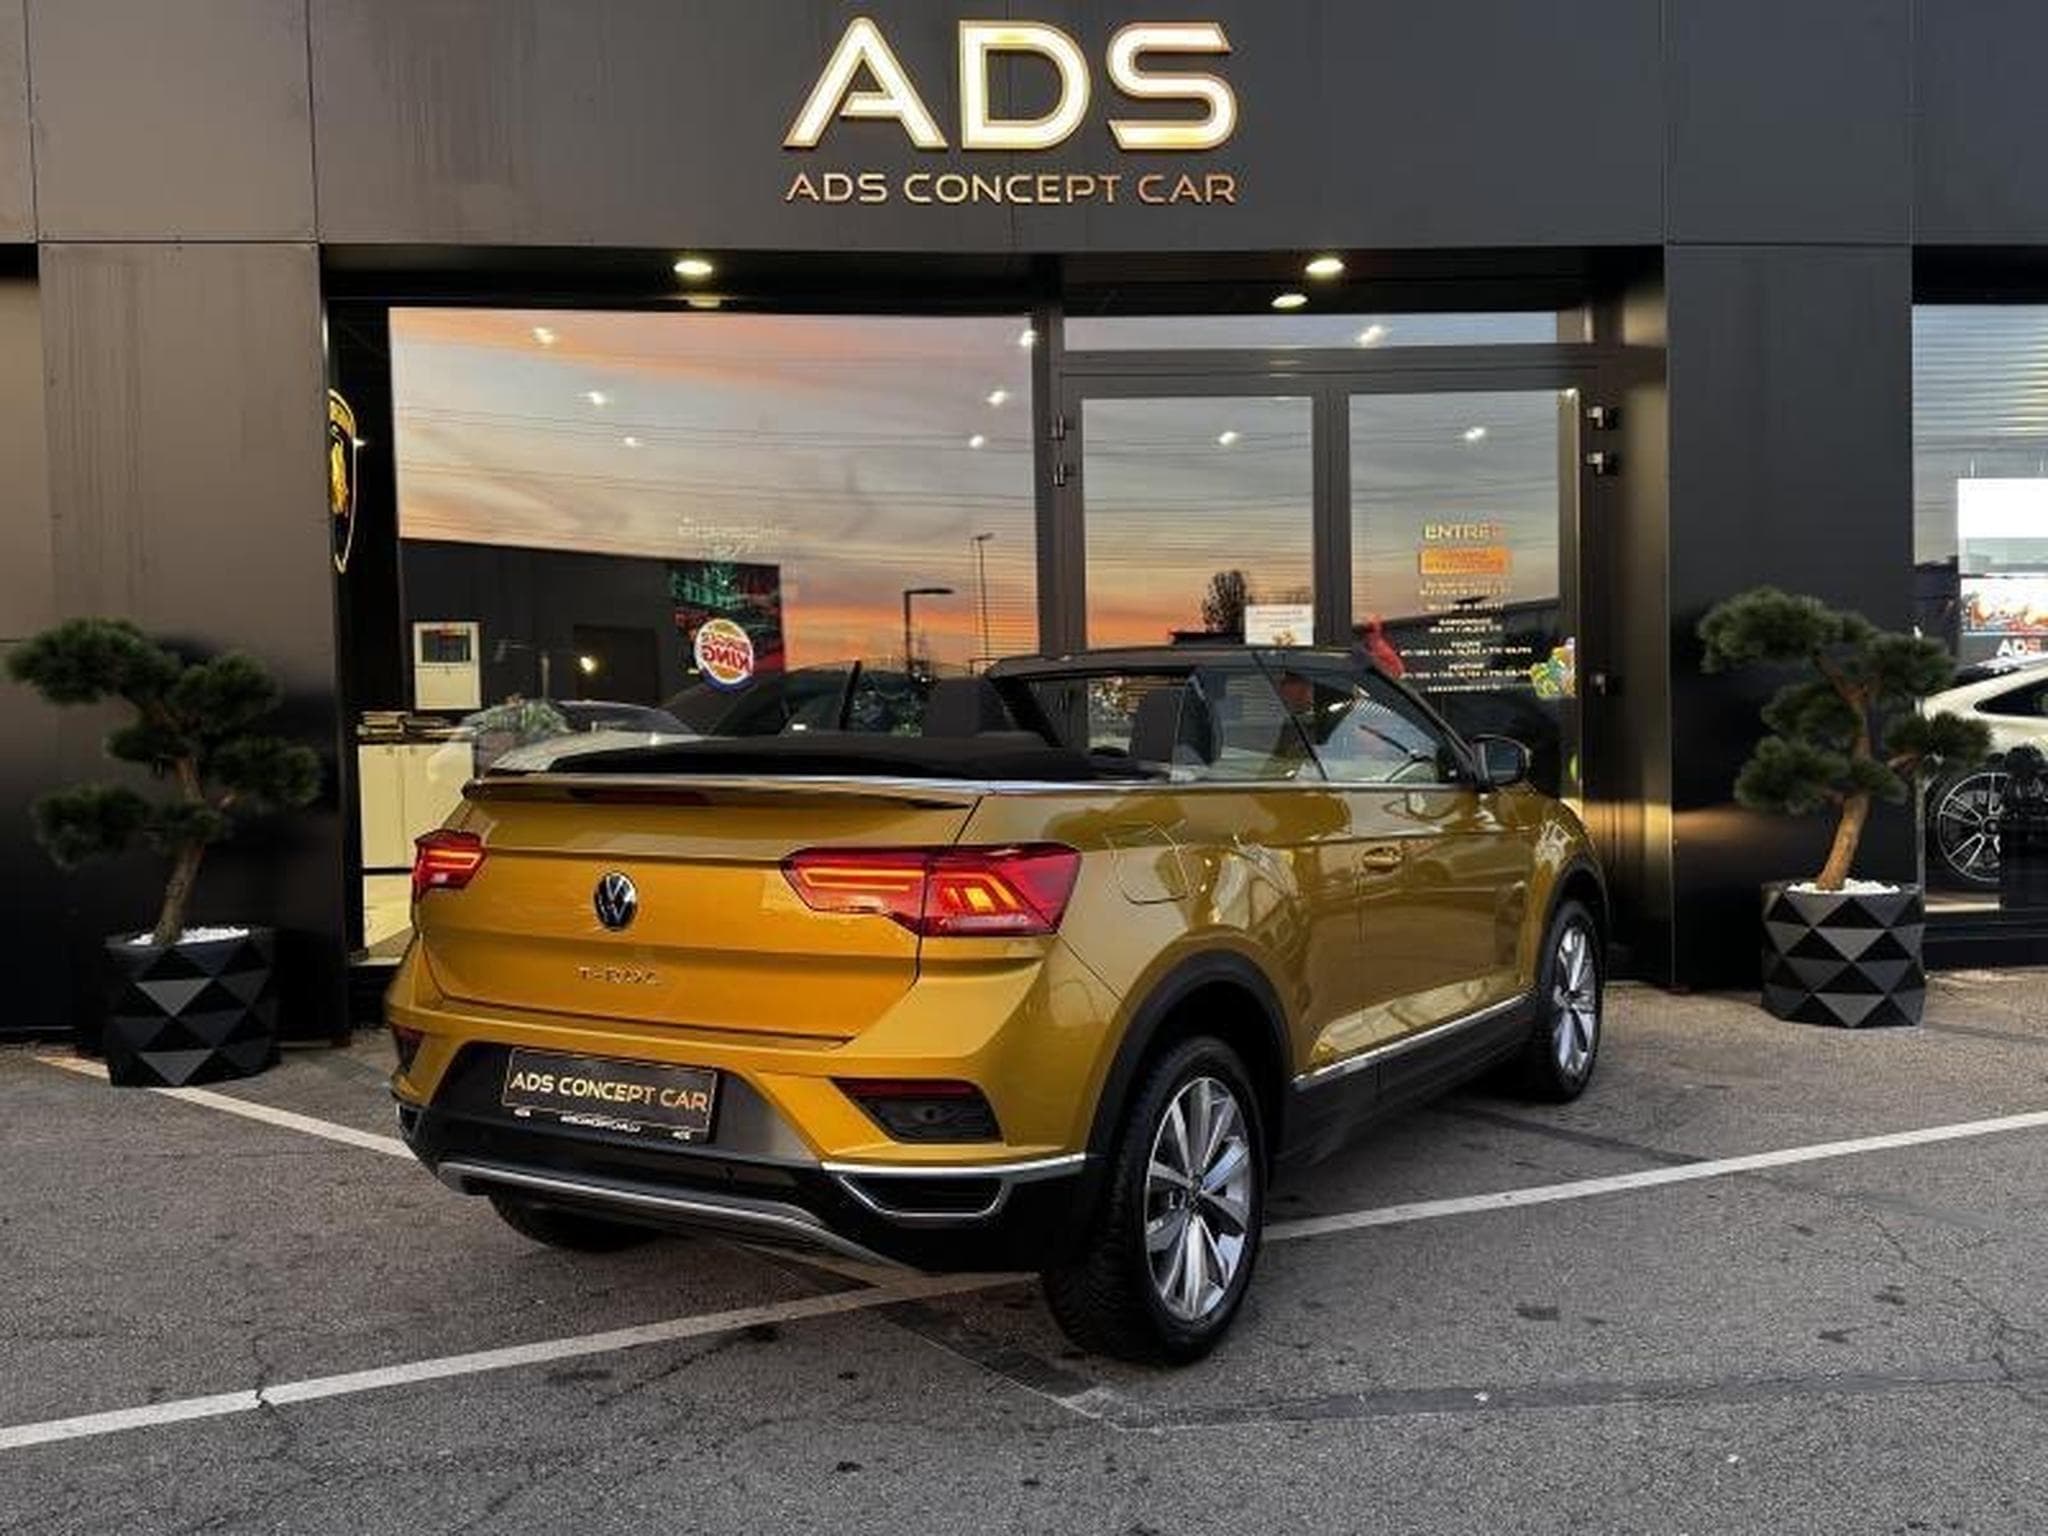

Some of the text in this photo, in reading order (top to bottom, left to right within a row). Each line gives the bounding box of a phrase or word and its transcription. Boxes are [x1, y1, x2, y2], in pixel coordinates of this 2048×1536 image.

[783, 17, 1238, 150] ADS
[785, 173, 1237, 204] ADS CONCEPT CAR
[510, 1071, 708, 1113] ADS CONCEPT CAR
